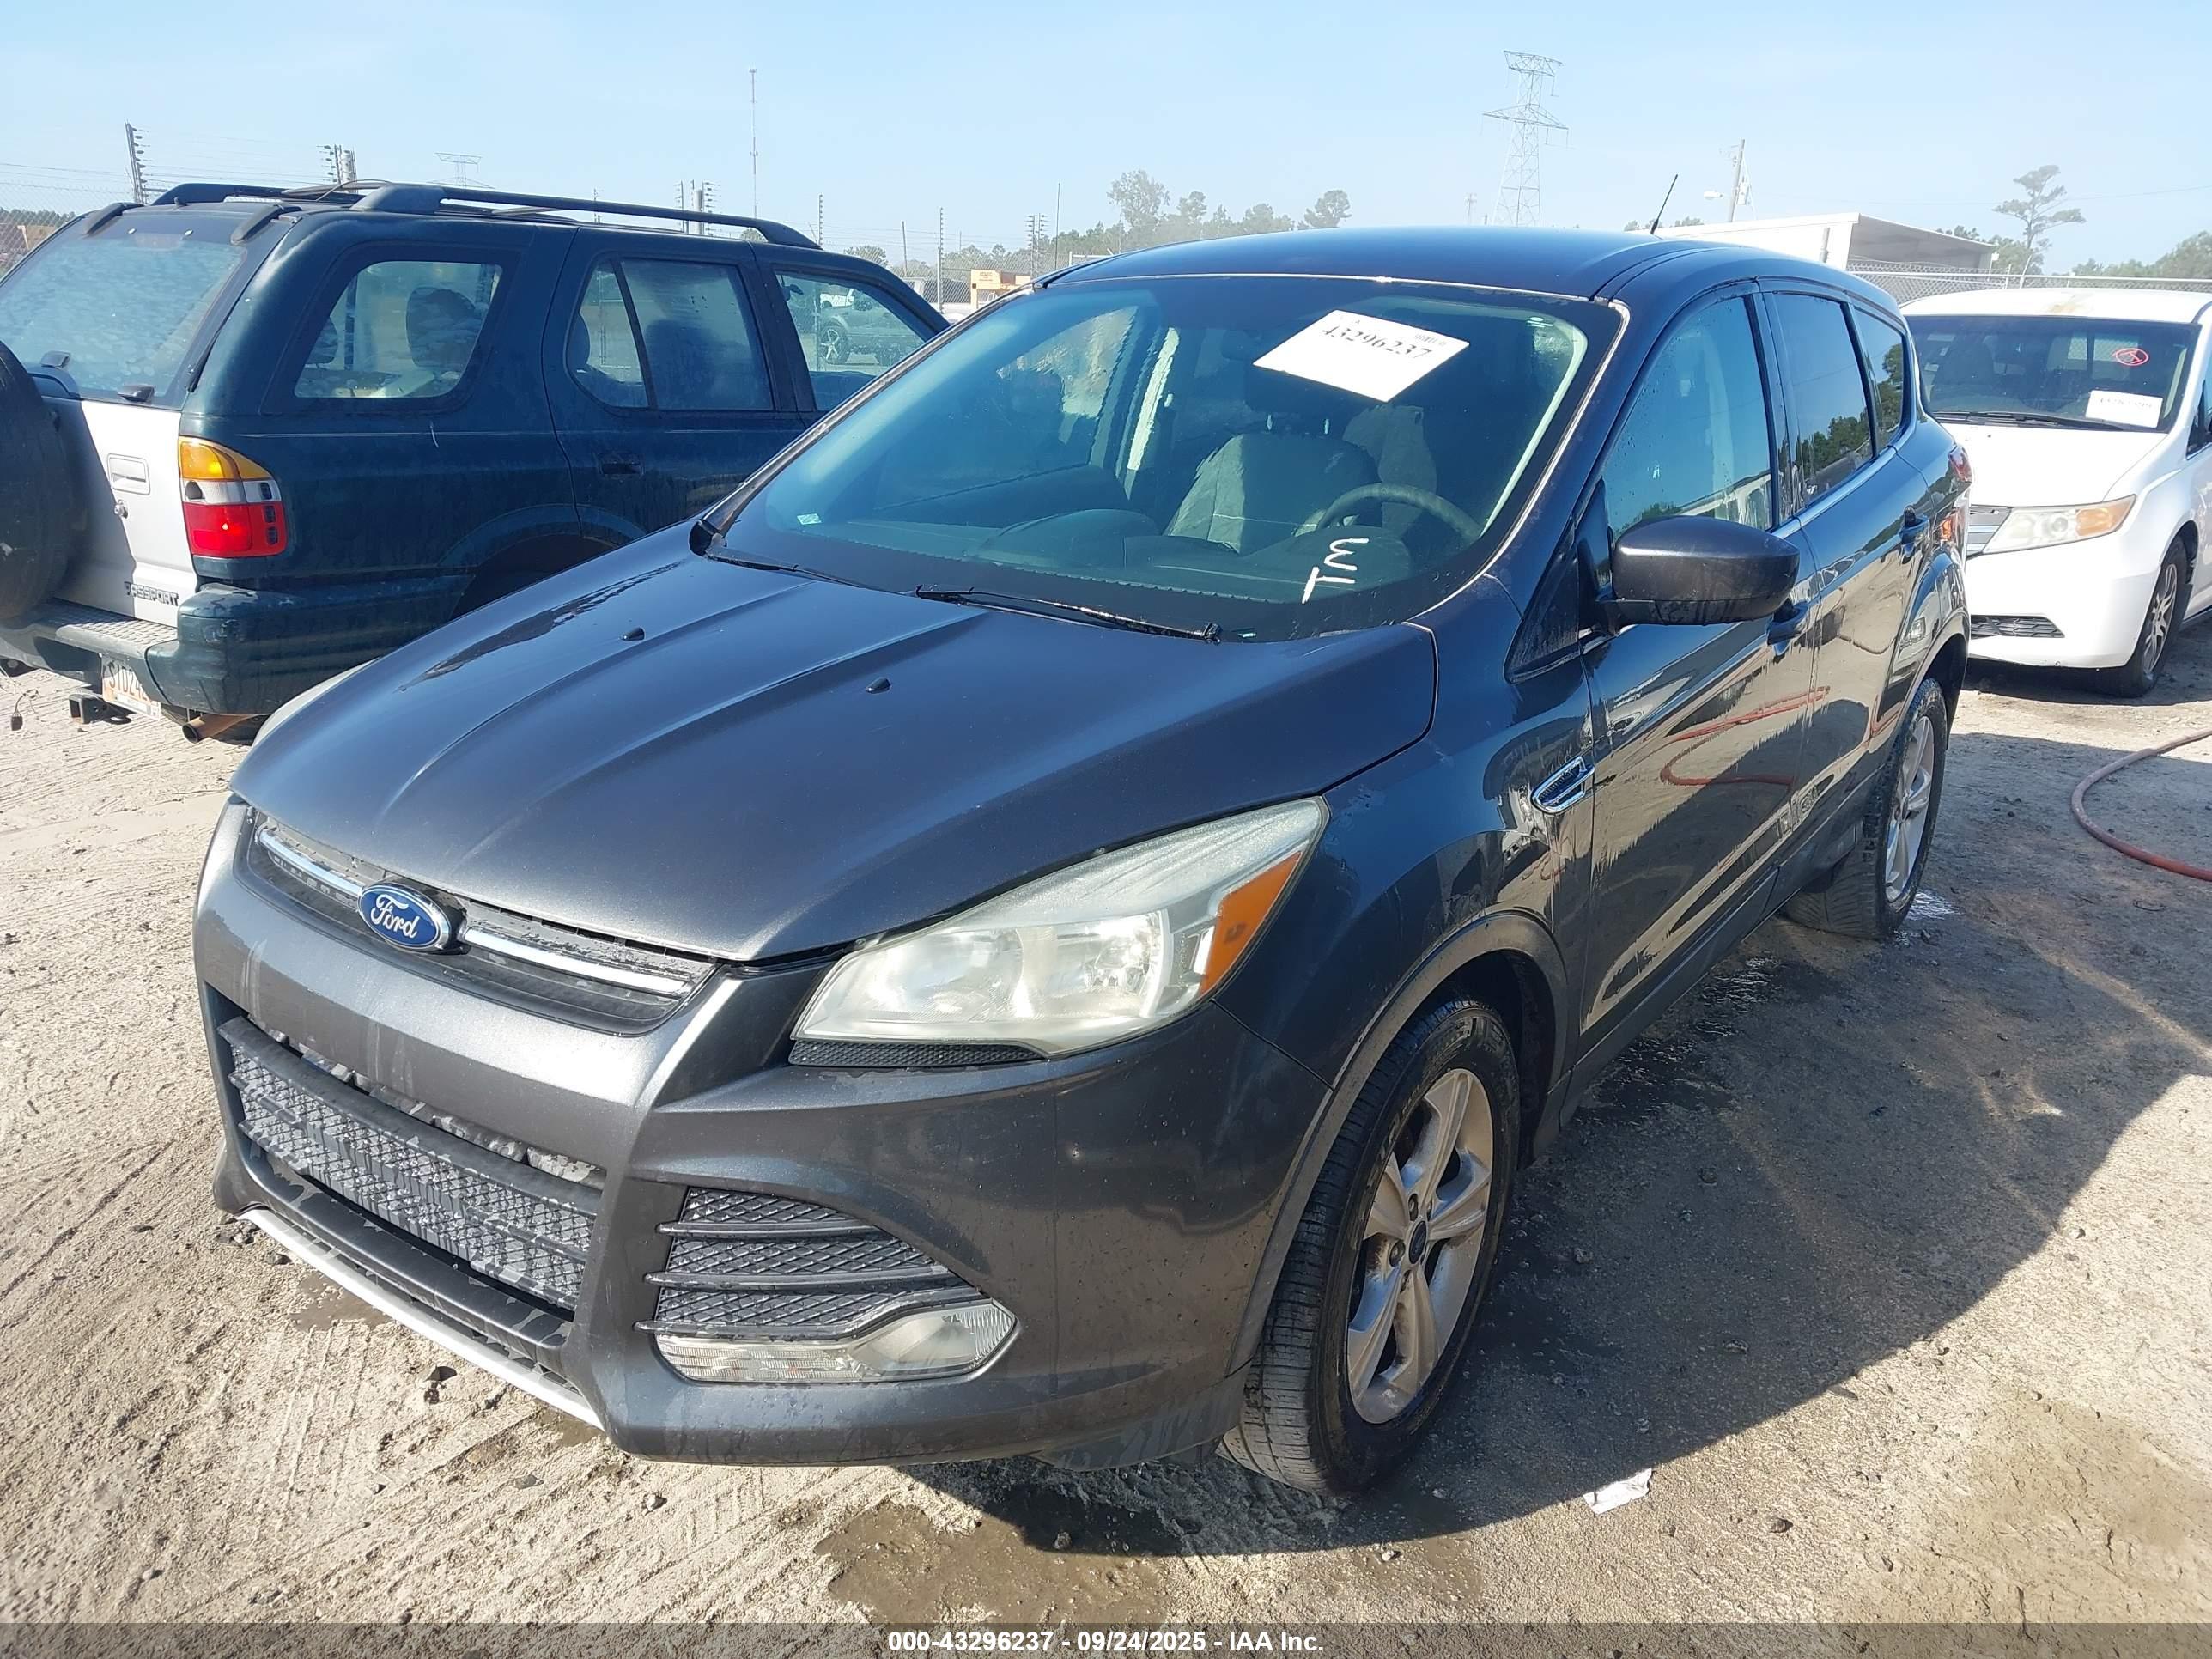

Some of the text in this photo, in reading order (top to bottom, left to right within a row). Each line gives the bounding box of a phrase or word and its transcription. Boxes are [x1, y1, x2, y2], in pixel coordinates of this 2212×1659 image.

[1321, 325, 1433, 359] 43296237
[124, 581, 179, 606] PASSPORT
[370, 894, 421, 939] Ford
